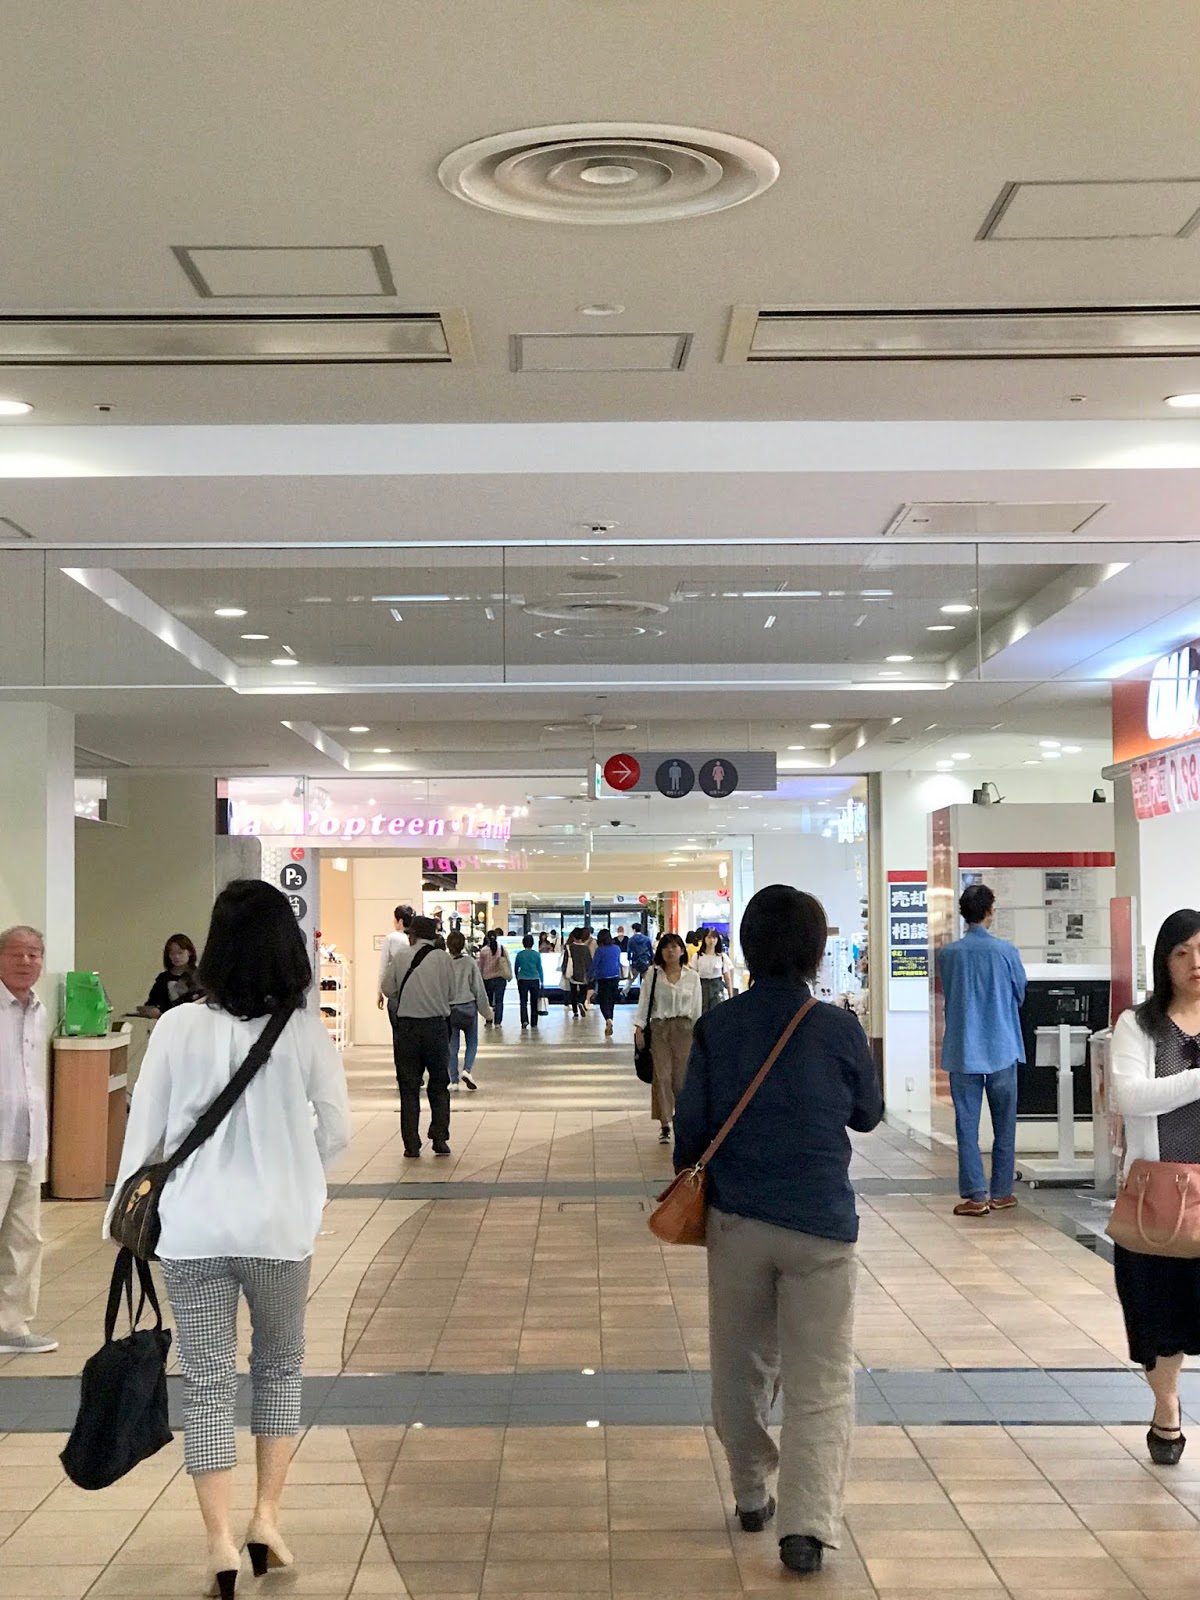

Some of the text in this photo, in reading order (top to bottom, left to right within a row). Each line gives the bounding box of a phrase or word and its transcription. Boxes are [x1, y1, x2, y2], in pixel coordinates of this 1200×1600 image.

[291, 808, 444, 840] Popteen
[466, 812, 512, 839] Land
[285, 868, 303, 886] P3
[891, 890, 928, 907] 売却
[891, 922, 929, 940] 相談
